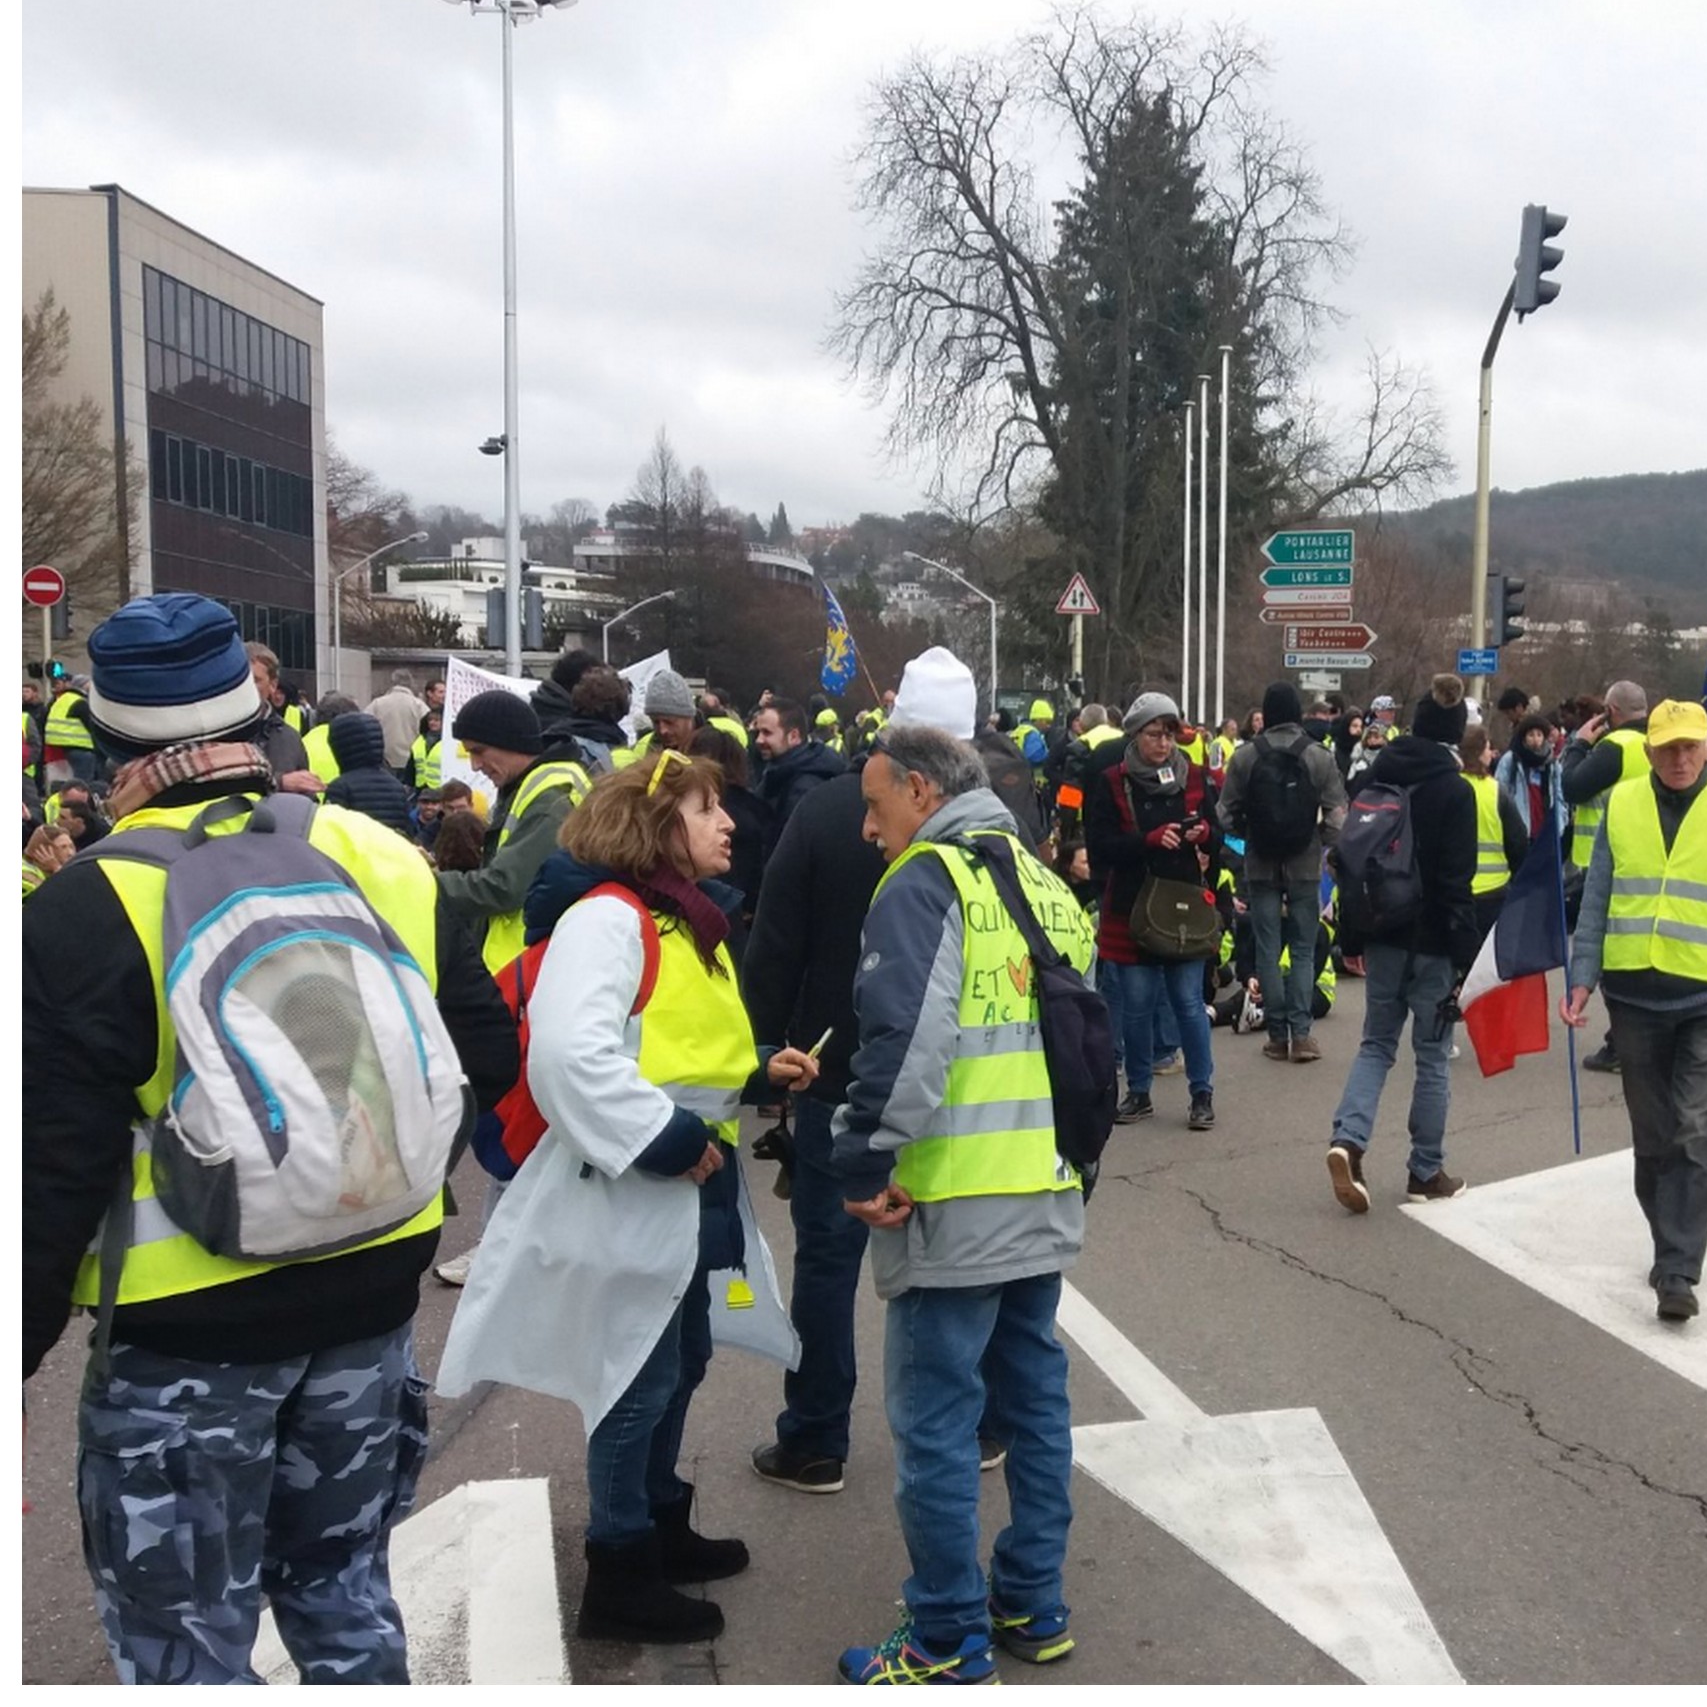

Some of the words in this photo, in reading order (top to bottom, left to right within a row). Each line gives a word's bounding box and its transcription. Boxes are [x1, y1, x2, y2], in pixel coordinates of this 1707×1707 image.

[1284, 536, 1350, 547] PONTARLIER
[1294, 549, 1350, 560] LAUSANNE
[1291, 572, 1319, 582] LONS
